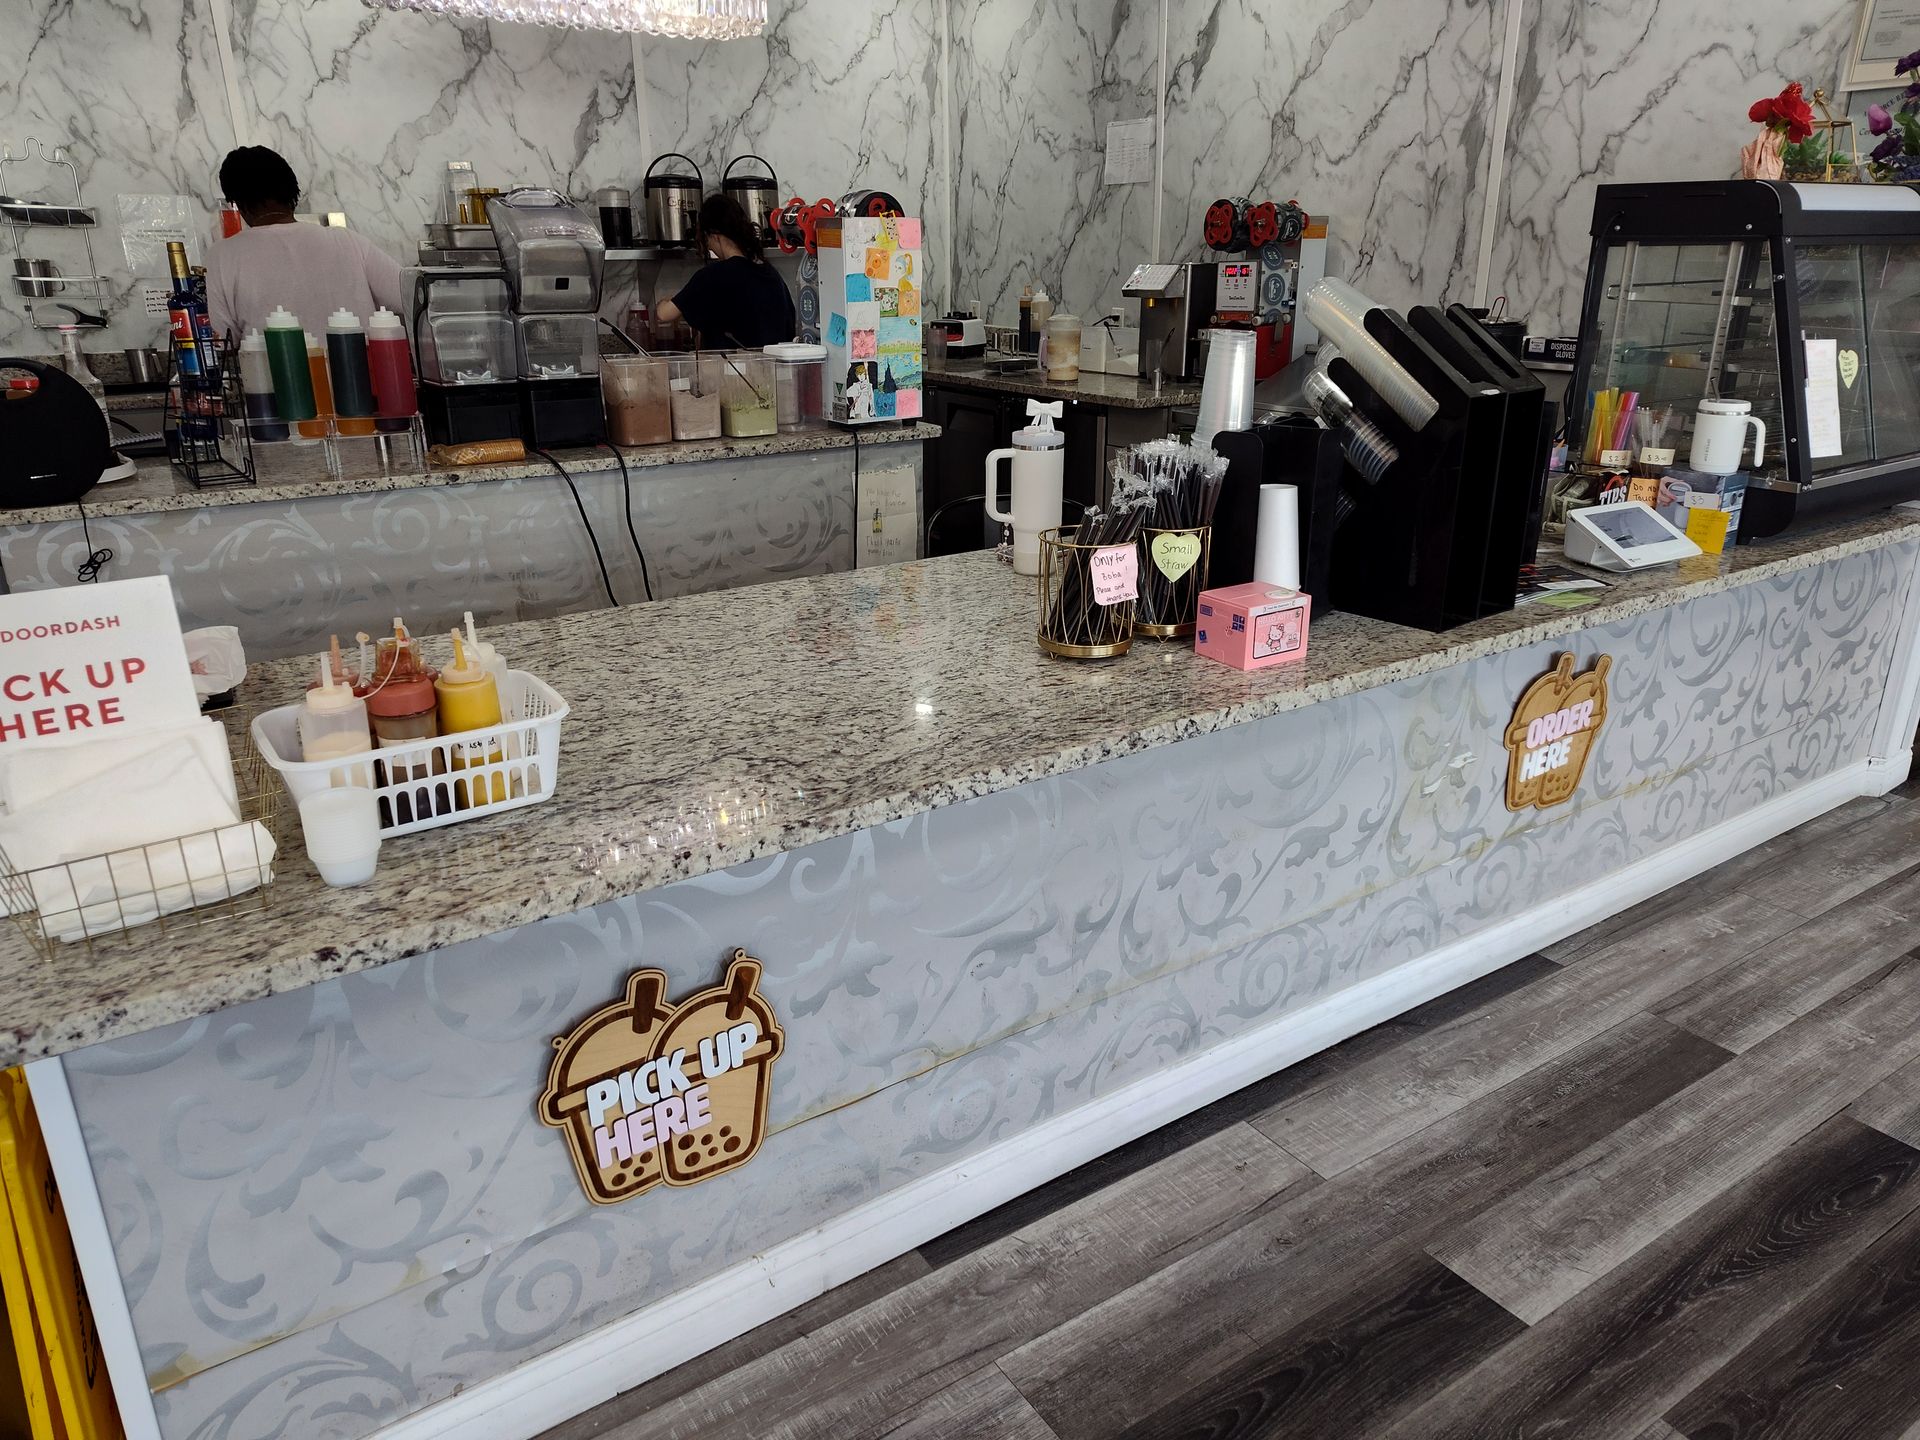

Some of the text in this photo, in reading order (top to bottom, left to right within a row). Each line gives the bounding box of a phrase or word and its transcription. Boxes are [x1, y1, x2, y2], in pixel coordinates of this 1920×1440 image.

[1555, 350, 1576, 359] GLOVES
[1599, 485, 1627, 506] TIPS
[1093, 552, 1127, 568] Only for
[1160, 542, 1193, 555] Small
[1114, 582, 1125, 591] and
[0, 615, 121, 643] DOORDASH
[85, 657, 146, 689] UP
[0, 697, 125, 743] HERE
[1526, 699, 1594, 749] ORDER
[1519, 736, 1573, 783] HERE
[586, 1022, 758, 1128] PICK UP
[594, 1083, 712, 1169] HERE
